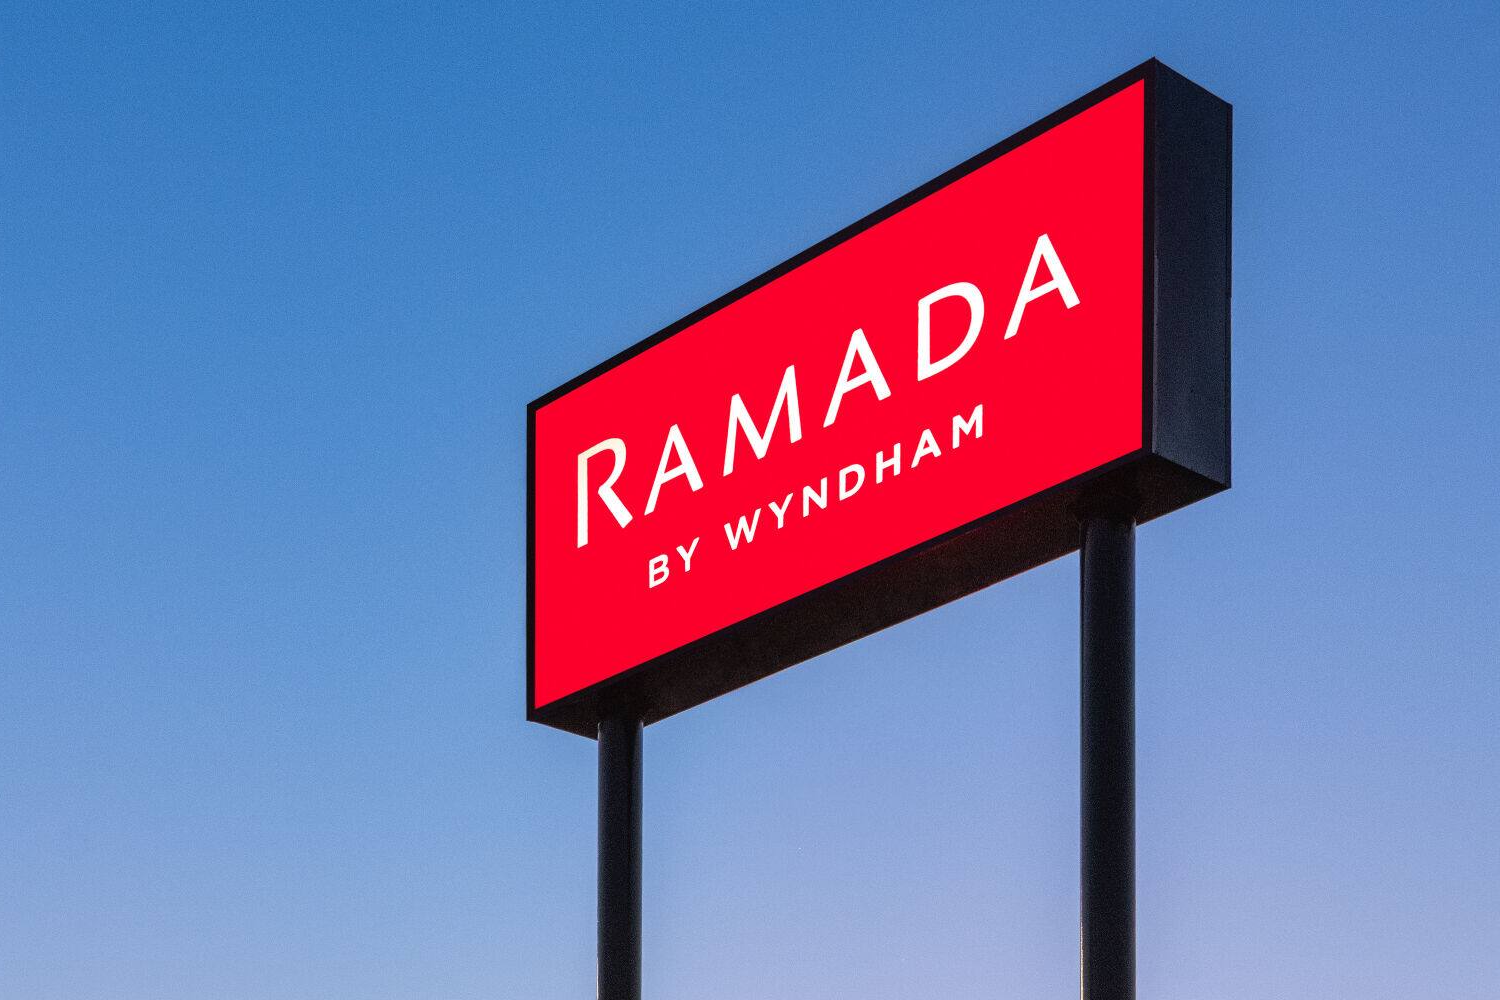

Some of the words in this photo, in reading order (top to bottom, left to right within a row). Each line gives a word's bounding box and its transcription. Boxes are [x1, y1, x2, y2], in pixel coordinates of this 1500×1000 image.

[576, 233, 1081, 549] RAMADA
[648, 536, 700, 589] BY
[723, 403, 985, 551] WYNDHAM
